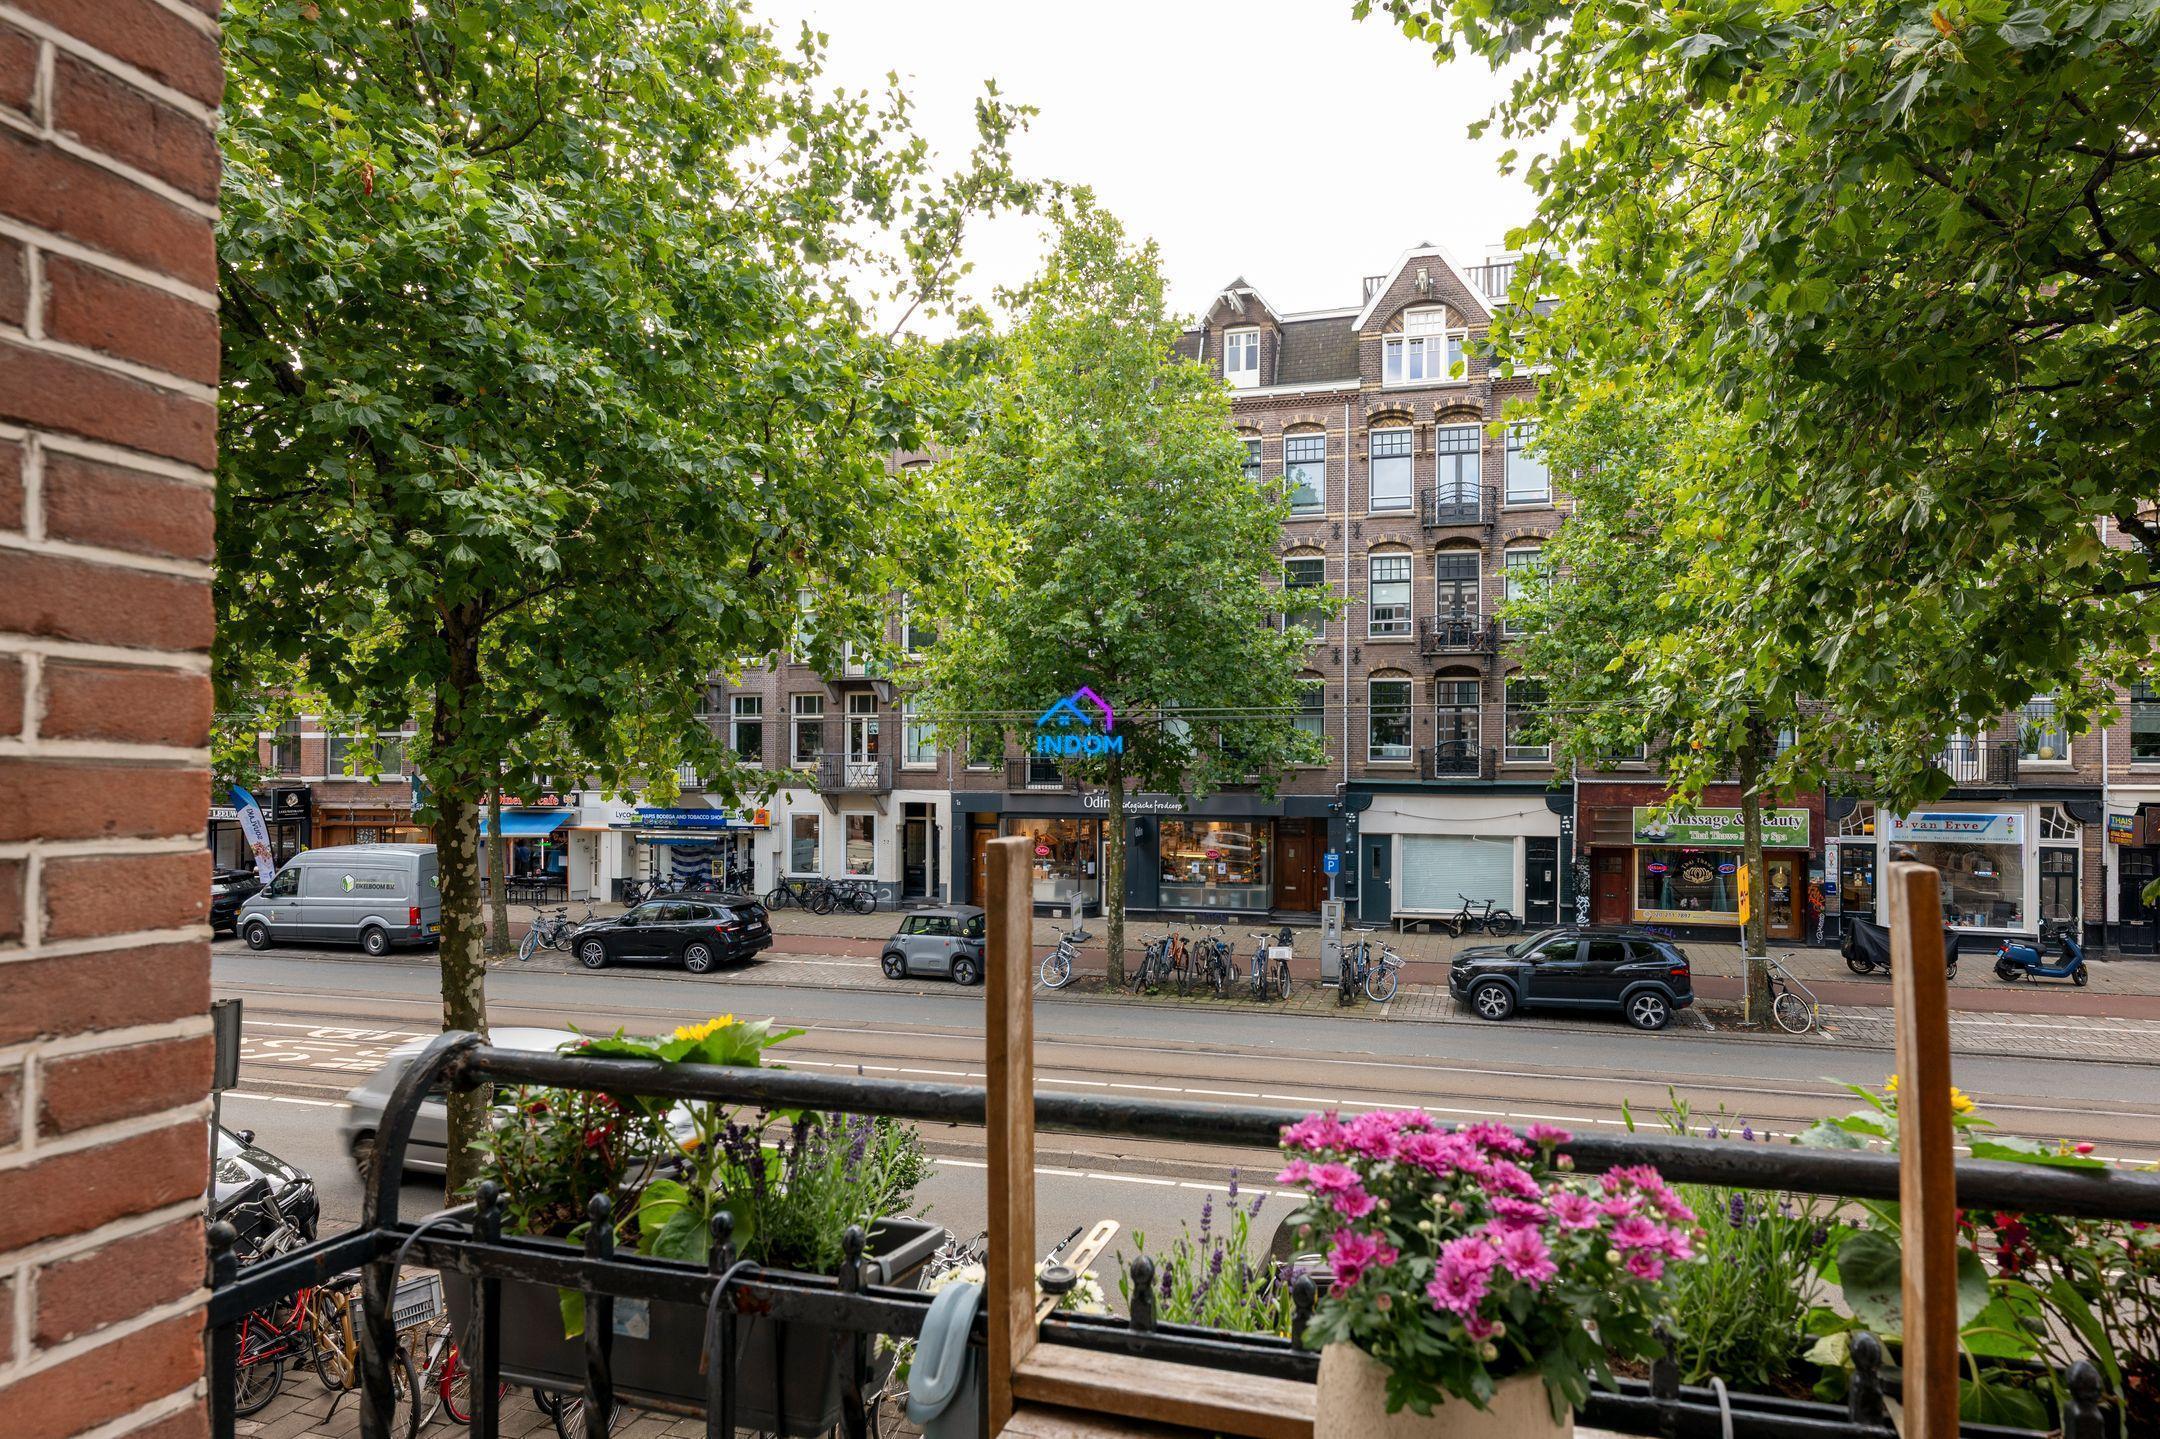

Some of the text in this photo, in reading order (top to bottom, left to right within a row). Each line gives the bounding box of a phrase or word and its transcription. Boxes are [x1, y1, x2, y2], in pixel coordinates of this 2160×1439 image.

[1083, 795, 1111, 808] Odin
[1667, 812, 1803, 830] Massage & eauty
[1944, 820, 1979, 830] Erve
[2110, 815, 2133, 826] THAIS
[1689, 831, 1709, 840] Thai
[1770, 831, 1788, 843] Spa
[1328, 861, 1335, 870] P
